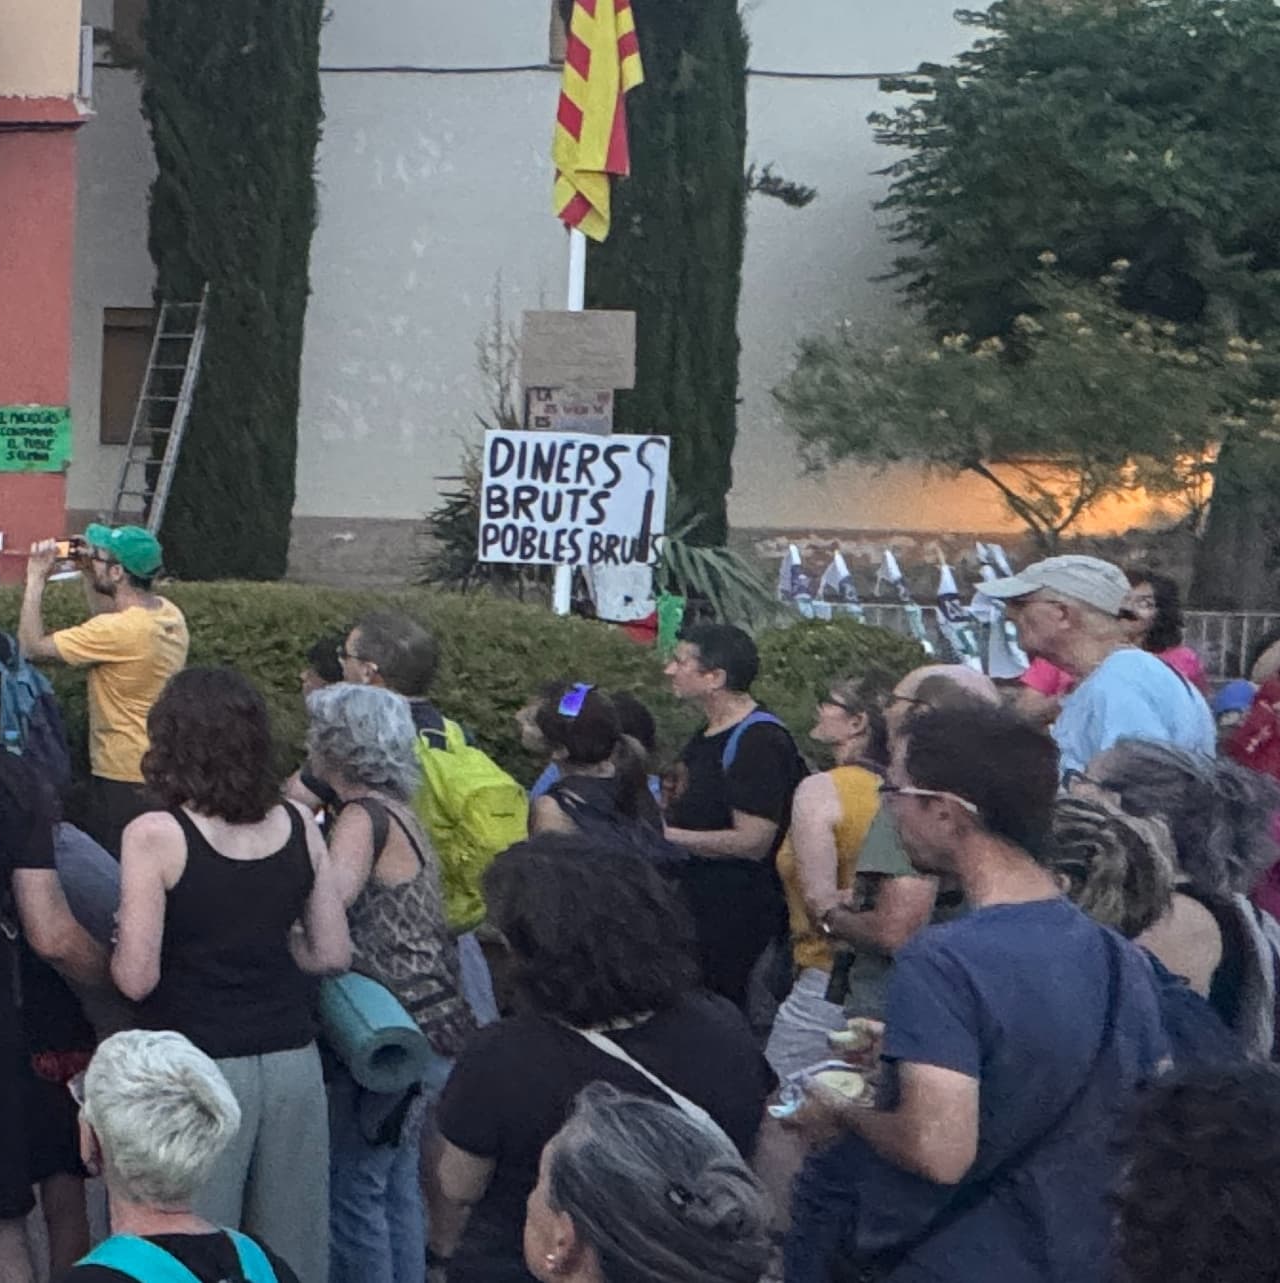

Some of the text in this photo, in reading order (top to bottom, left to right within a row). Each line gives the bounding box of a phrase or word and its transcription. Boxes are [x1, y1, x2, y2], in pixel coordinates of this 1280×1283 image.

[490, 437, 630, 489] DINERS
[486, 484, 611, 526] BRUTS
[482, 523, 663, 567] POBLES BRUS
